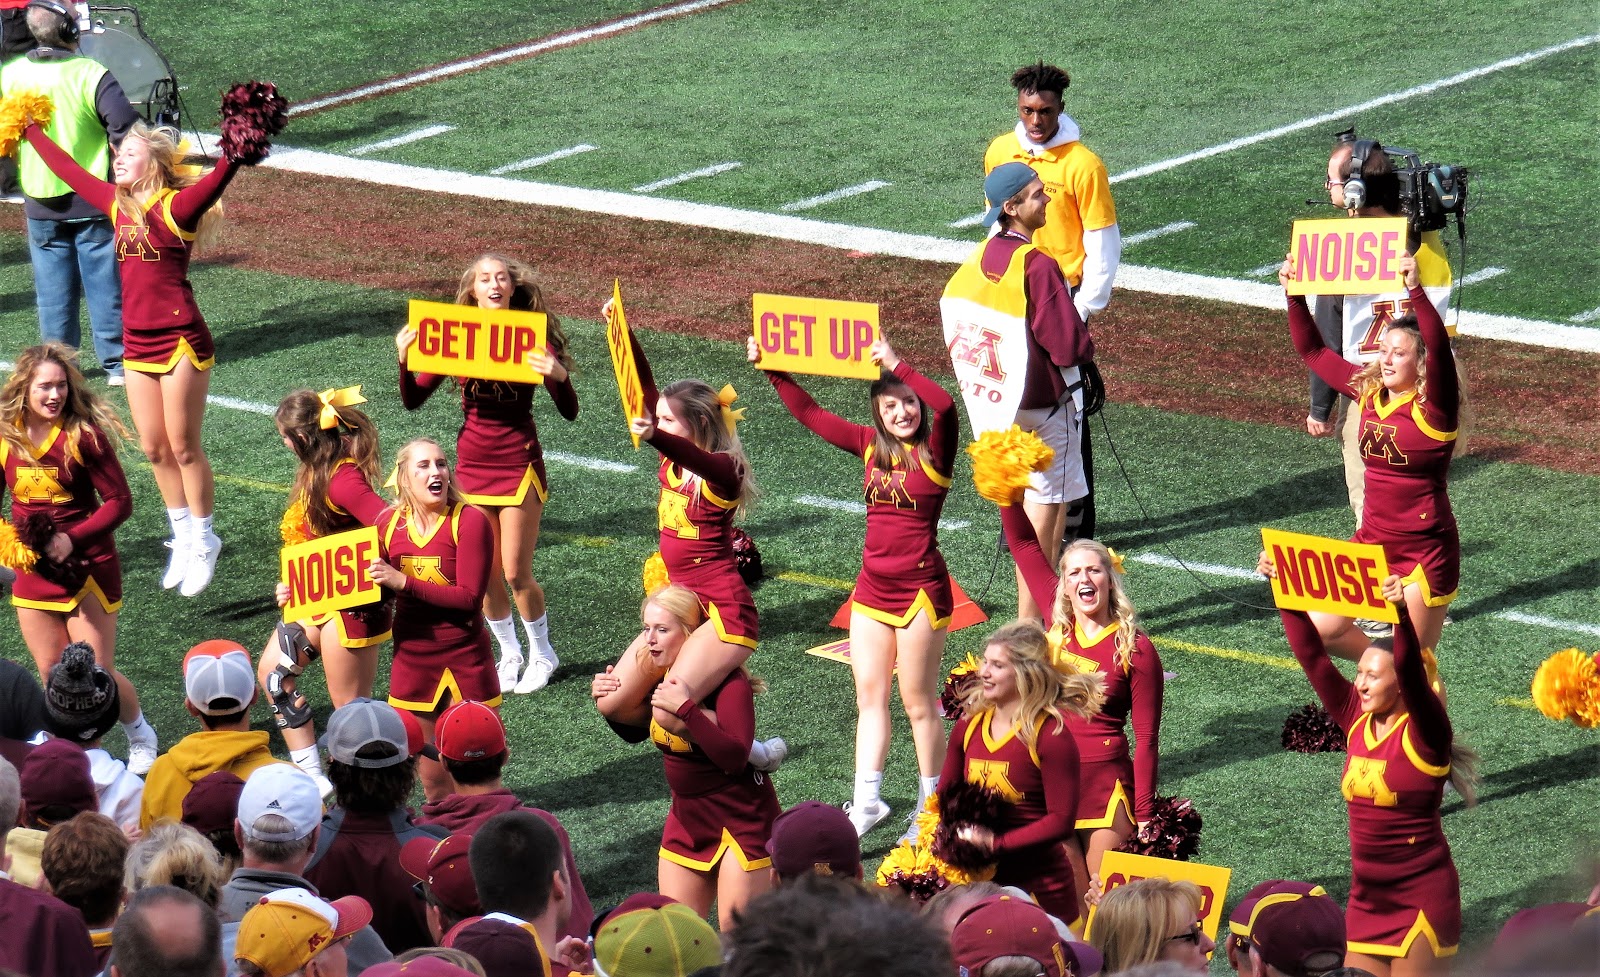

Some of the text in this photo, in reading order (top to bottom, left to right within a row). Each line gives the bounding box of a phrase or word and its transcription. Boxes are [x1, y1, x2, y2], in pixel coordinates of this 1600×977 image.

[1295, 231, 1399, 282] NOISE
[418, 317, 536, 365] GET UP
[611, 302, 627, 378] GET
[760, 311, 874, 362] GET UP
[288, 541, 374, 609] NOISE
[1272, 543, 1387, 609] NOISE
[48, 687, 107, 710] GOPHERS
